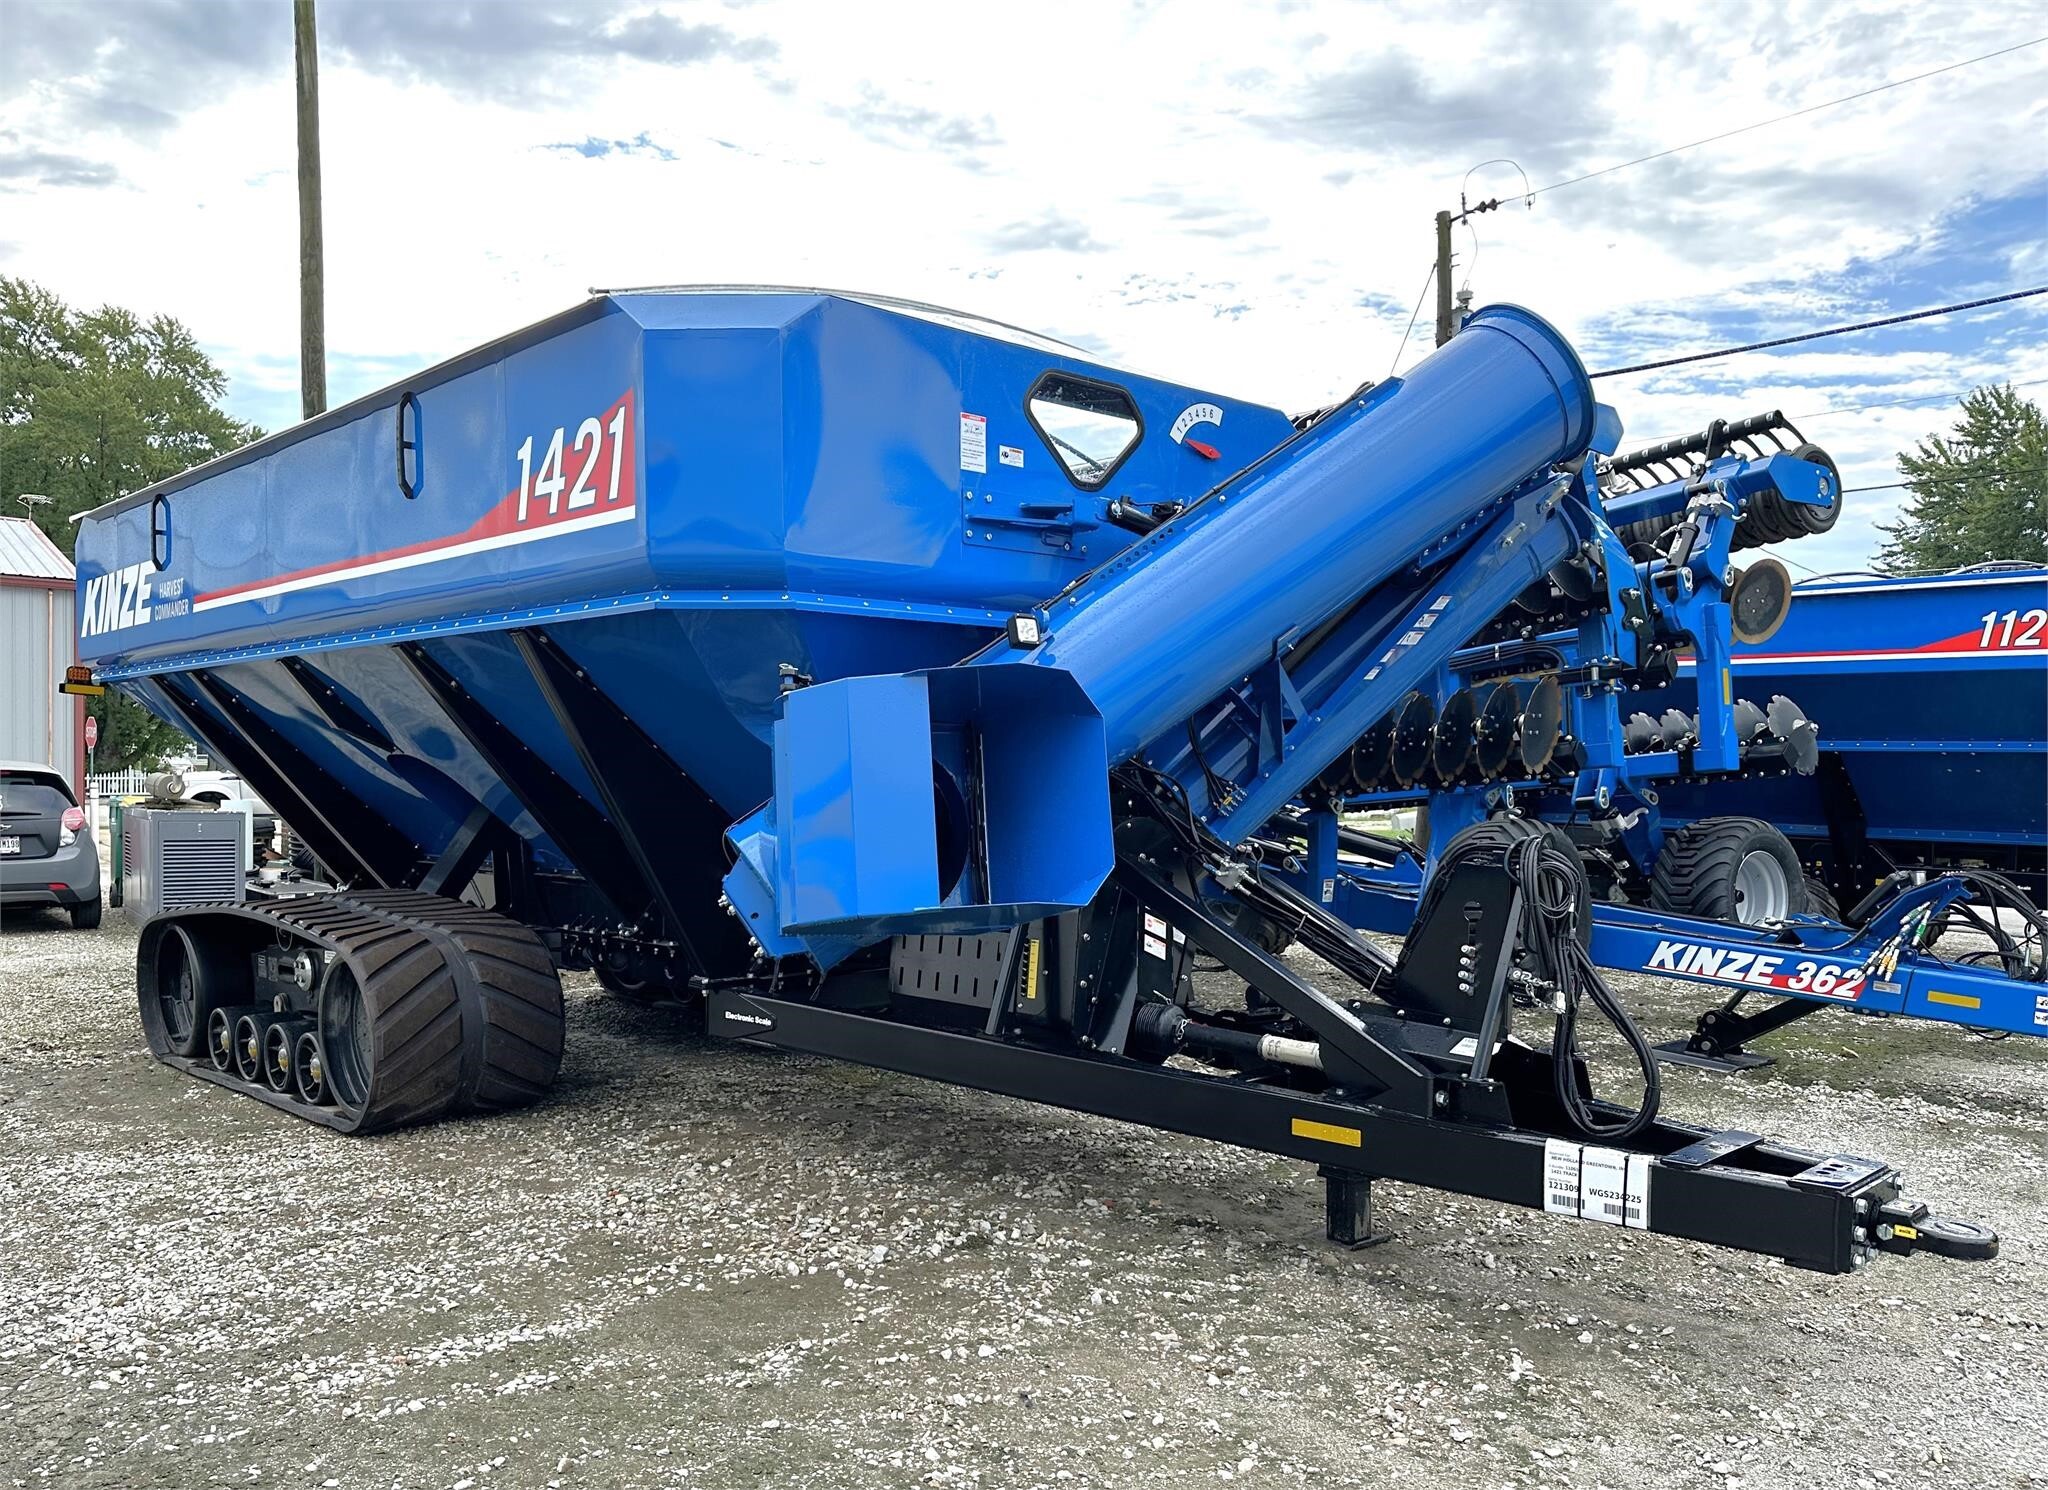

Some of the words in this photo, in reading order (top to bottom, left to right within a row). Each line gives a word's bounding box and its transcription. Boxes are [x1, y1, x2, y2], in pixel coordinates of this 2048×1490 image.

[1182, 418, 1187, 427] 2
[1188, 412, 1193, 421] 3
[1195, 409, 1199, 418] 4
[1202, 408, 1206, 417] 5
[1209, 409, 1213, 418] 6
[516, 405, 626, 521] 1421
[159, 577, 185, 599] HARVEST
[80, 559, 157, 638] KINZE
[154, 599, 190, 622] COMMANDER
[86, 726, 97, 738] STOP
[1648, 940, 1785, 986] KINZE
[1787, 960, 1867, 998] 362
[725, 1010, 755, 1023] Electronic
[755, 1015, 772, 1026] Scale
[1548, 1180, 1579, 1193] 121309
[1589, 1187, 1642, 1204] WGS234225
